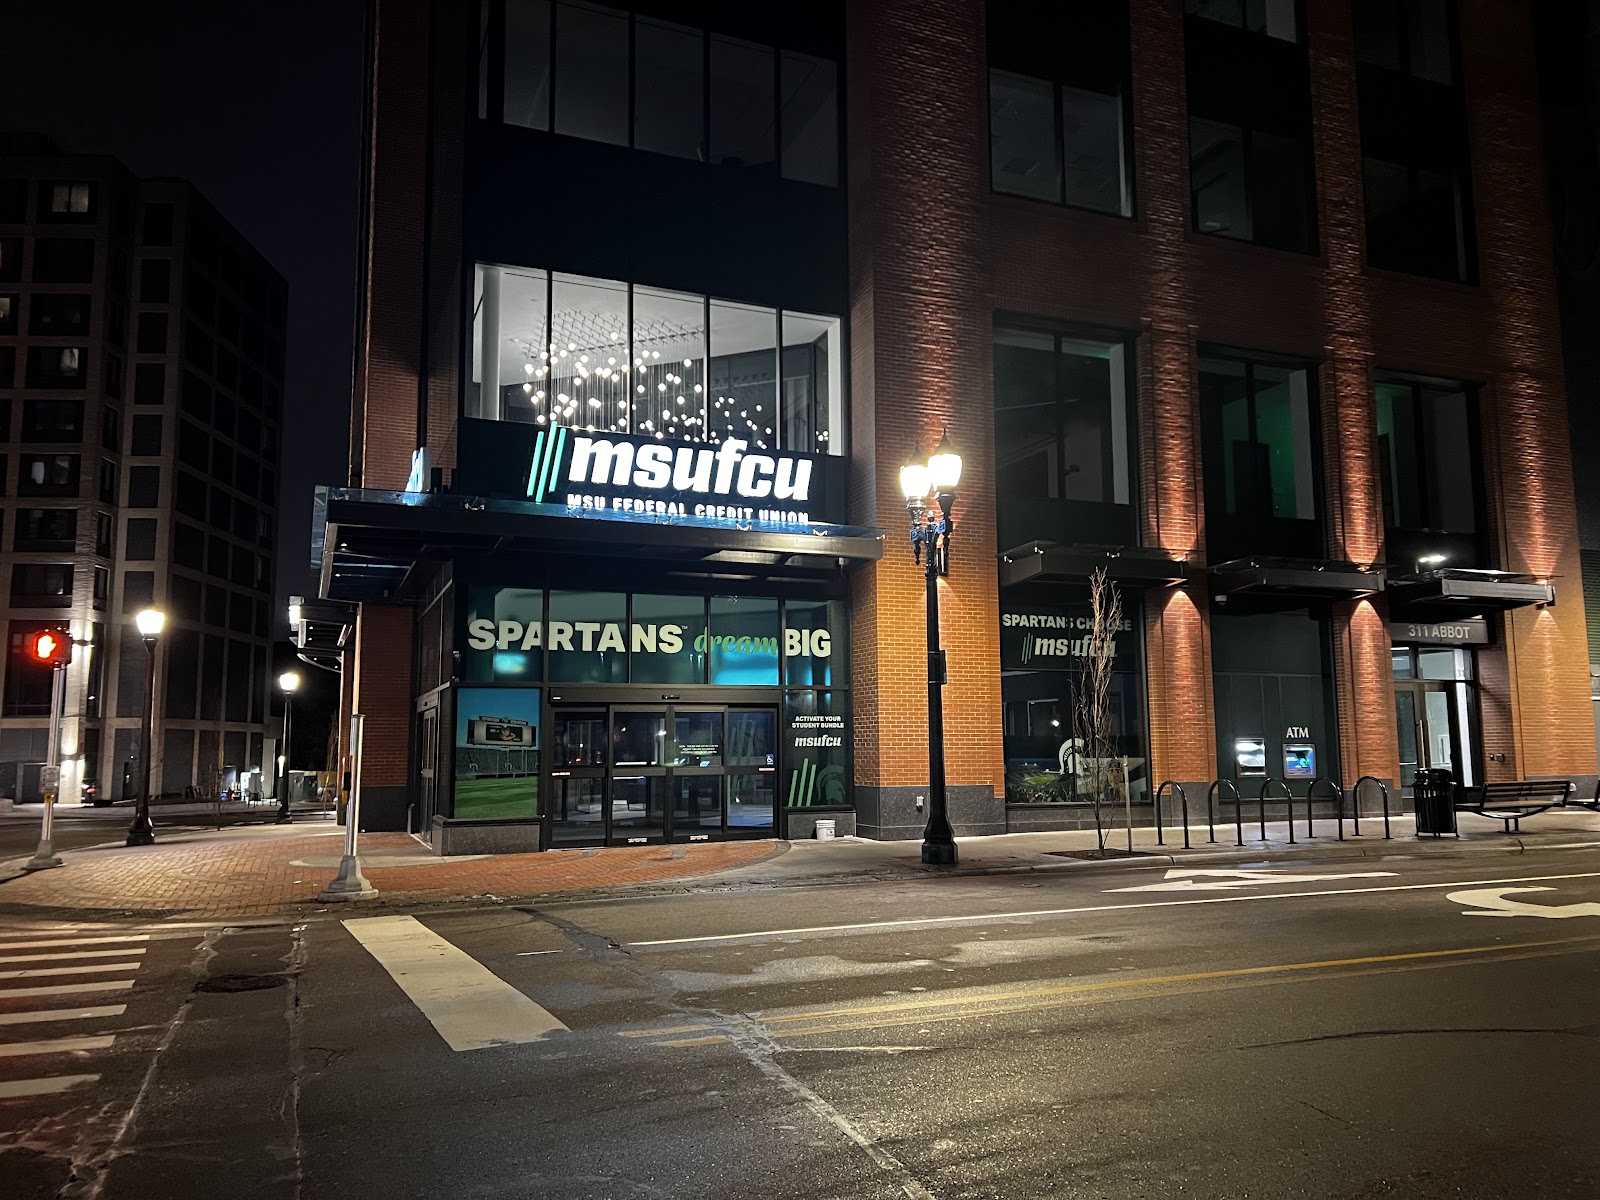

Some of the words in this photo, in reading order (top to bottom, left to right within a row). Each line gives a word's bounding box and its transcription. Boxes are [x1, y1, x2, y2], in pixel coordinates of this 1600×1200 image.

[568, 437, 812, 501] msufcu
[567, 493, 605, 510] MSU
[613, 498, 687, 516] FEDERAL
[695, 504, 754, 520] CREDIT
[759, 509, 810, 525] UNION
[1002, 614, 1074, 628] SPARTANS
[1408, 625, 1429, 637] 311
[1431, 625, 1470, 639] ABBOT
[694, 627, 778, 656] dream
[784, 629, 832, 657] BIG
[1286, 726, 1309, 739] ATM
[795, 734, 842, 747] msufcu
